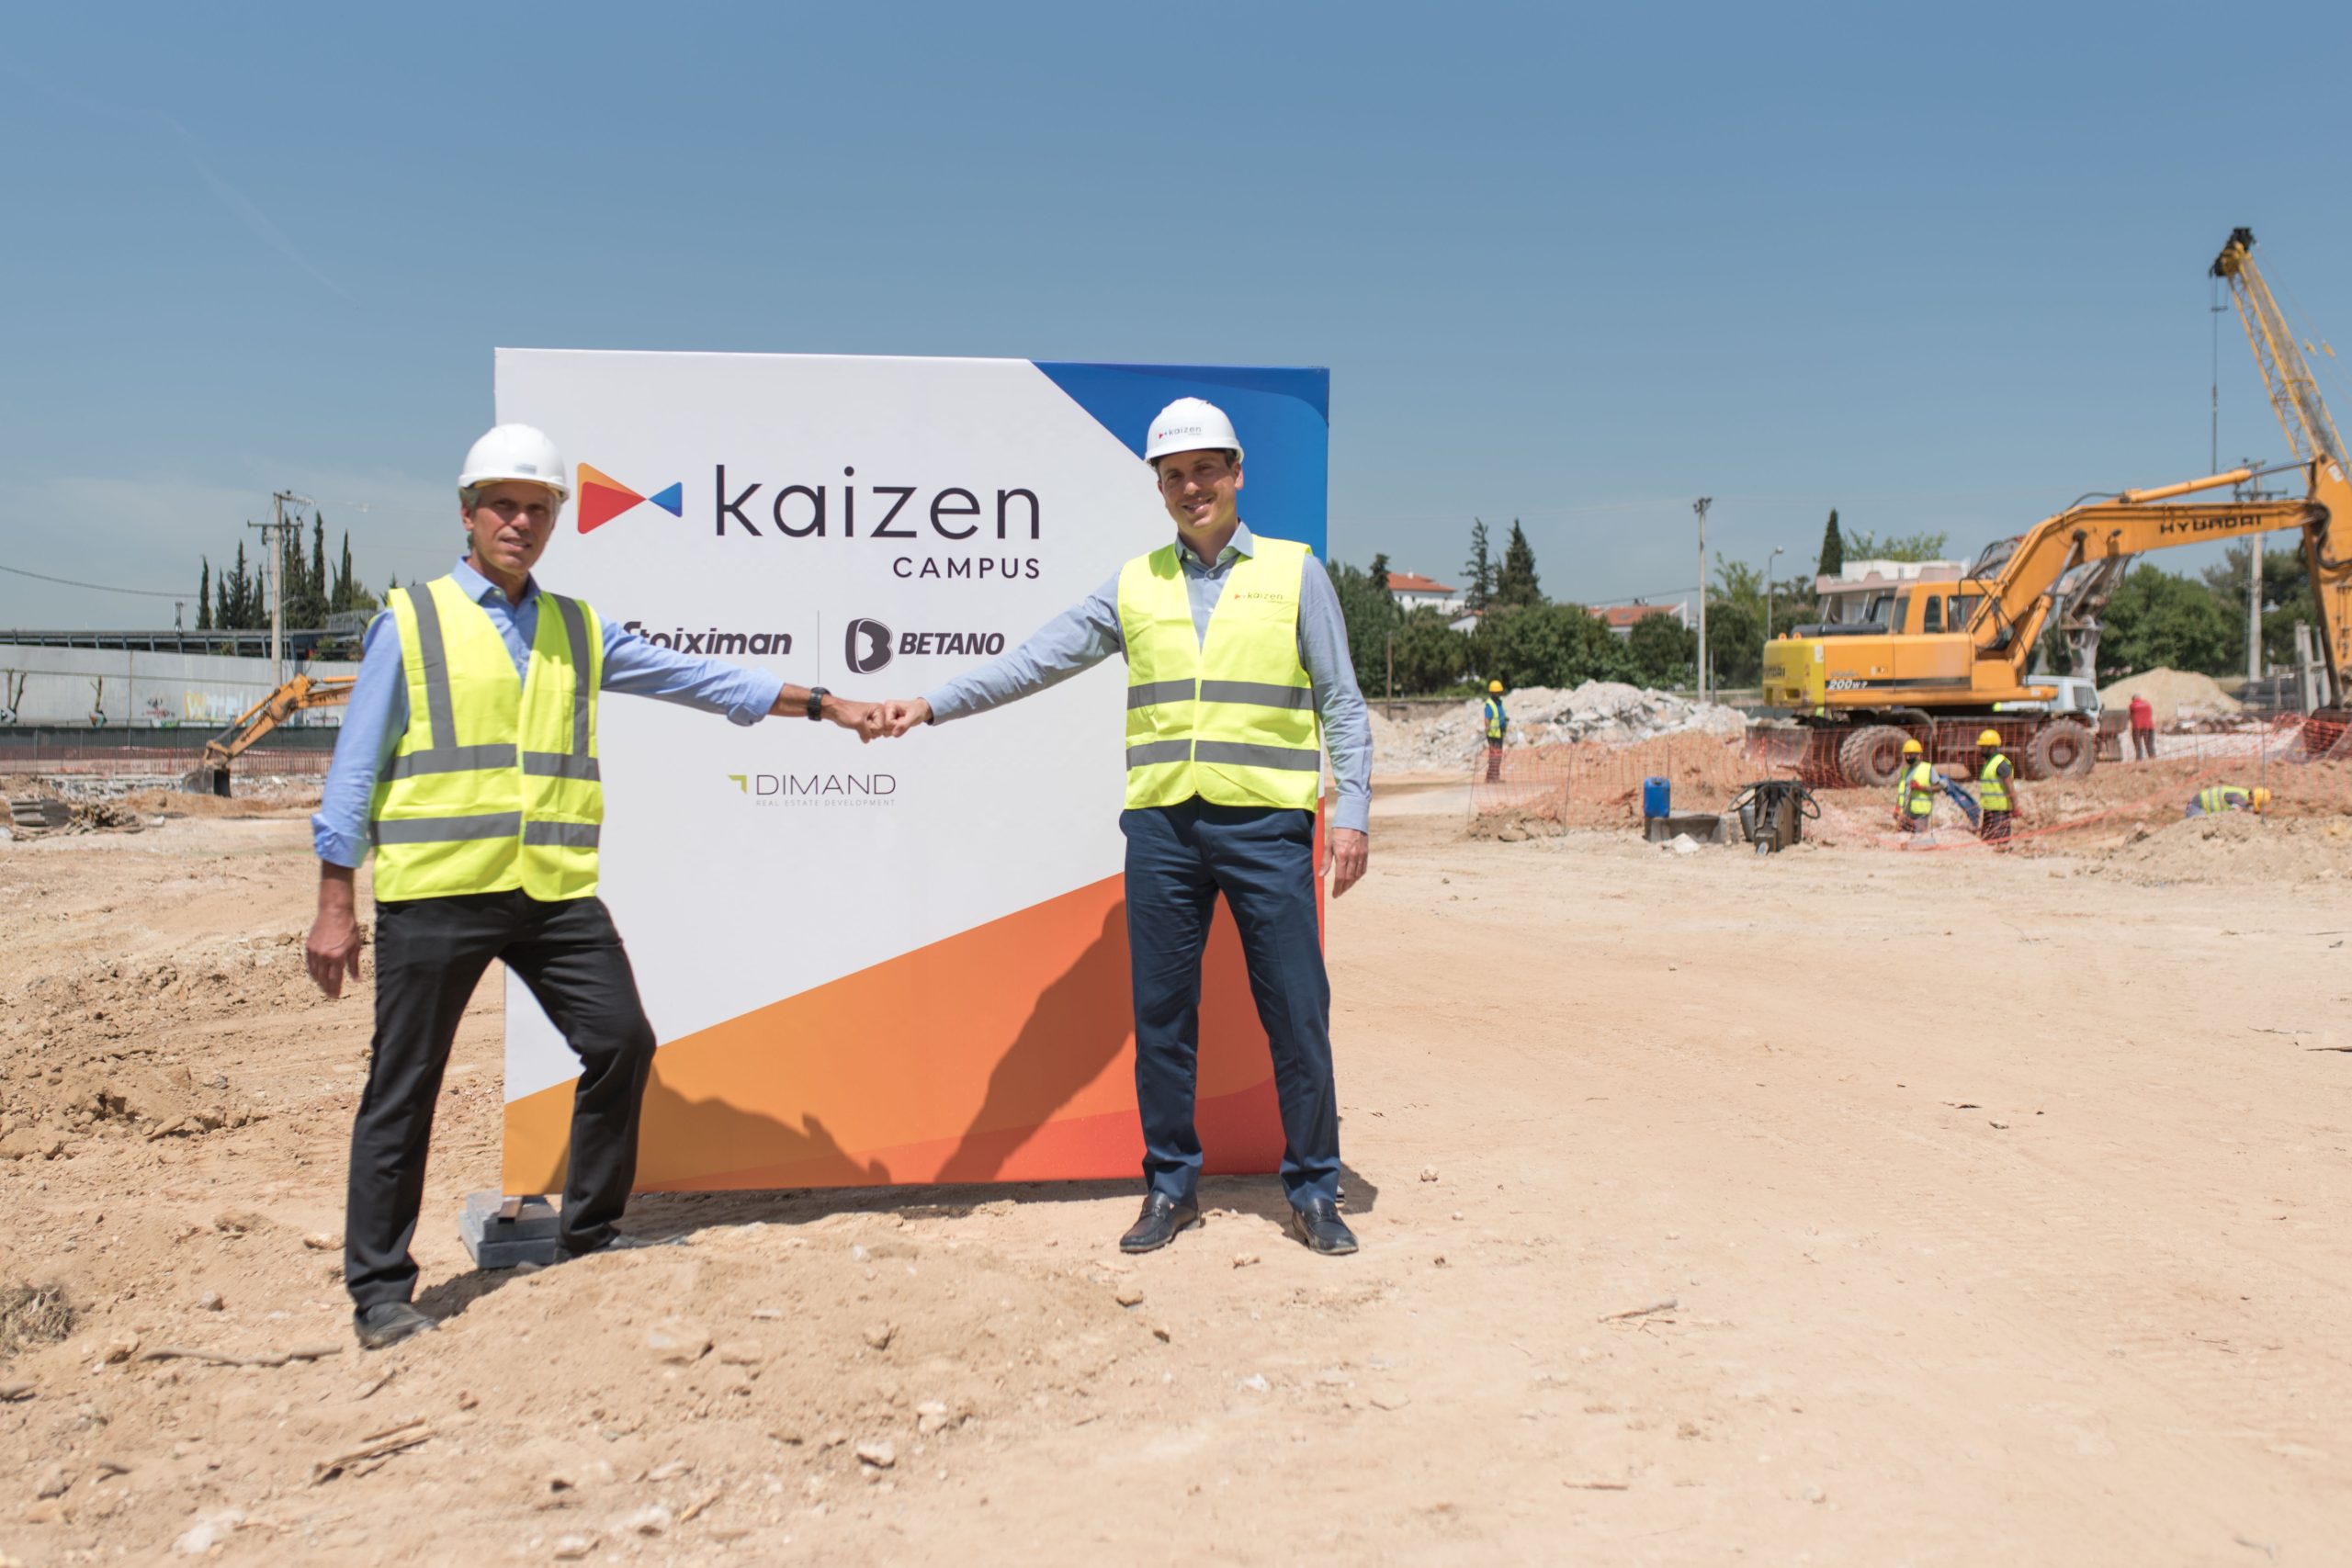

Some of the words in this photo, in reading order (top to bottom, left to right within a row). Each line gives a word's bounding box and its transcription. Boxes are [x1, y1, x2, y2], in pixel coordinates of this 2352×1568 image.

[716, 464, 1040, 540] kaizen
[2160, 514, 2261, 534] HYUNDAI
[893, 557, 1040, 579] CAMPUS
[899, 632, 1005, 655] BETANO
[756, 774, 897, 795] DIMAND
[756, 799, 780, 807] REAL
[785, 799, 820, 807] ESTATE
[824, 799, 896, 807] DEVELOPMENT
